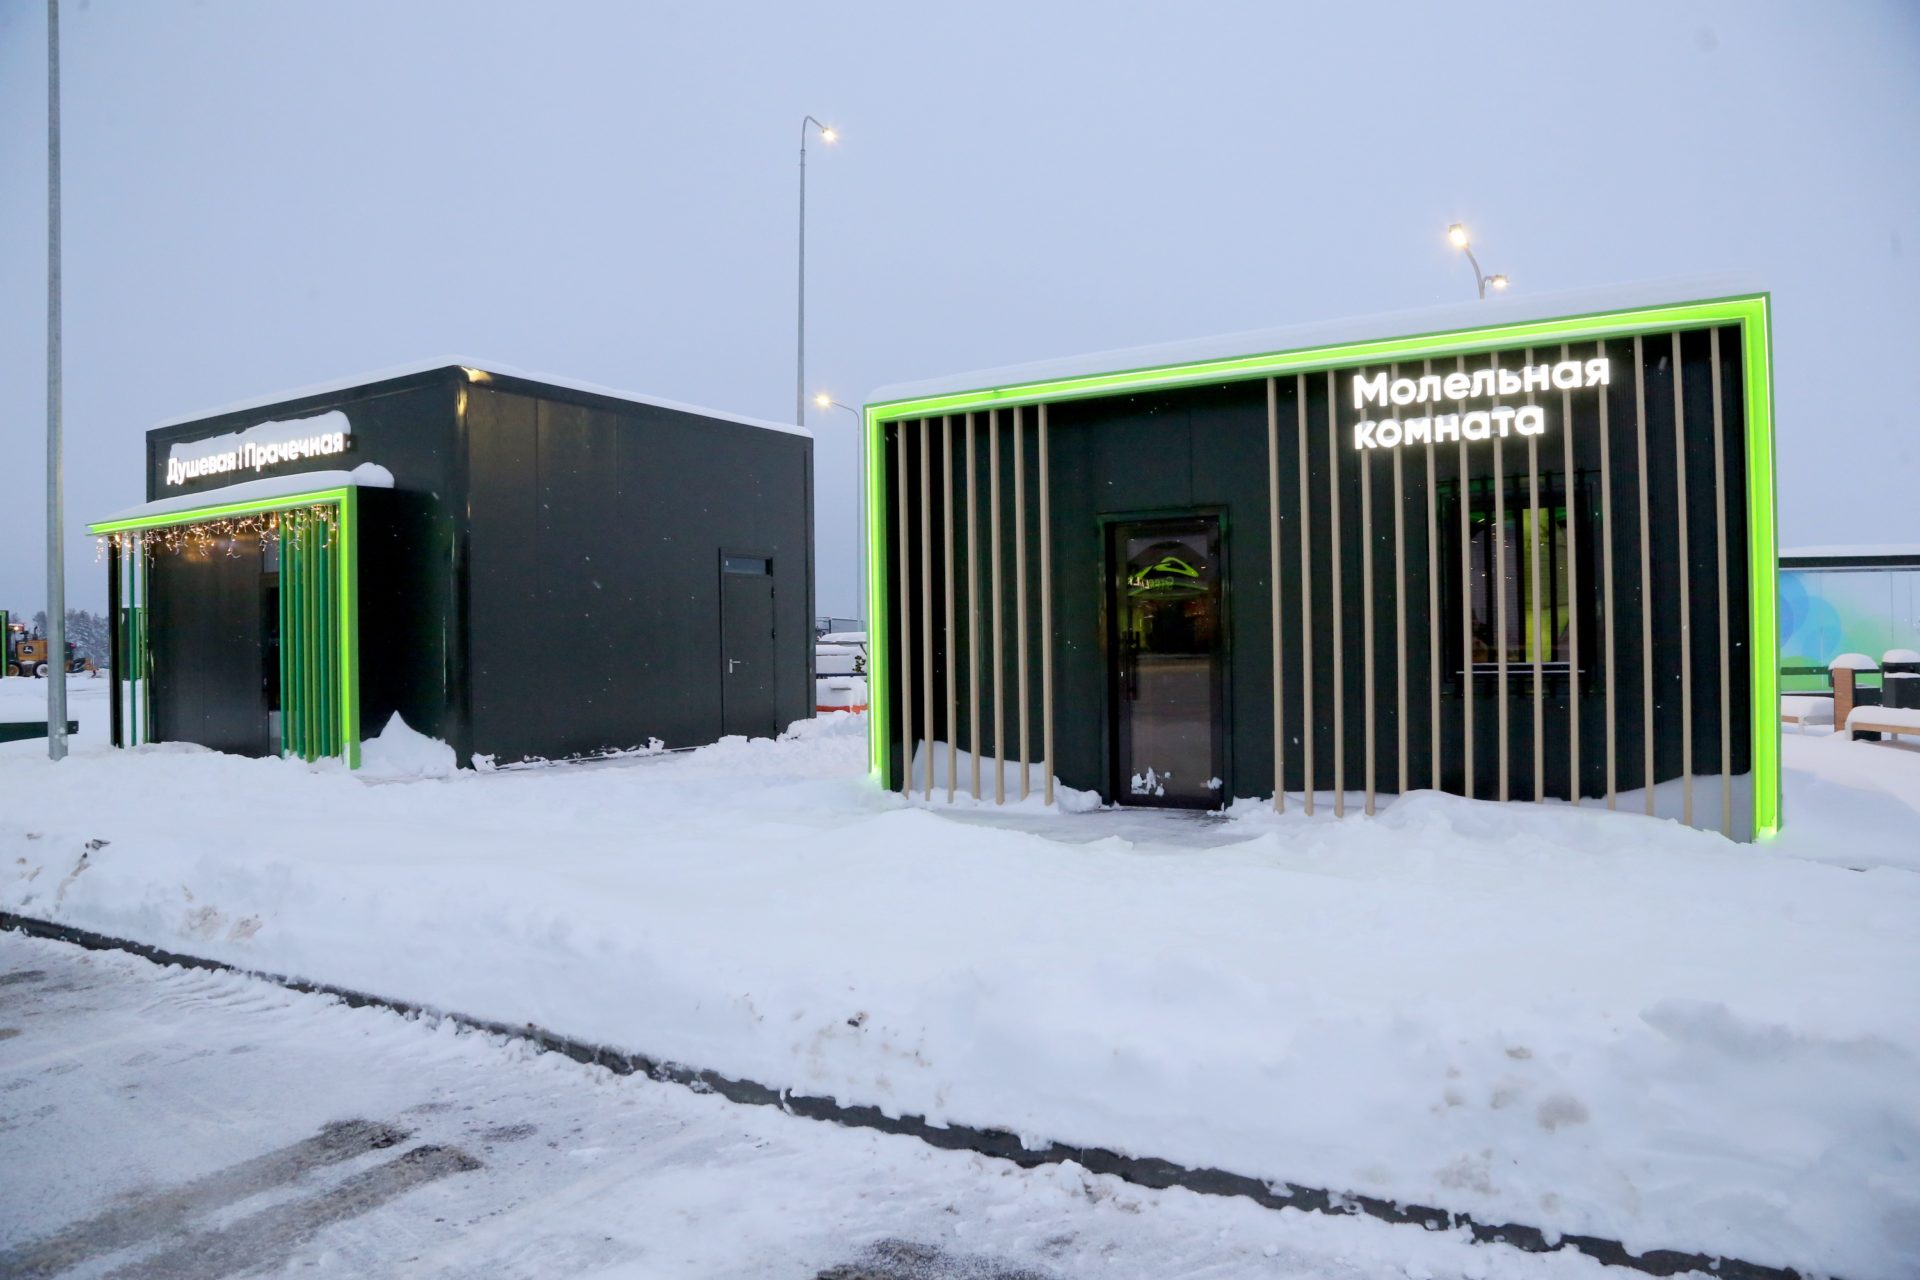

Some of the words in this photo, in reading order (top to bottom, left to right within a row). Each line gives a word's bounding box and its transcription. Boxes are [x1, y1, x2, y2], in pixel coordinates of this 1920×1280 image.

[1353, 357, 1610, 410] Молельная
[1354, 405, 1545, 450] комната
[166, 452, 236, 486] Душевая
[244, 432, 344, 472] Прачечная
